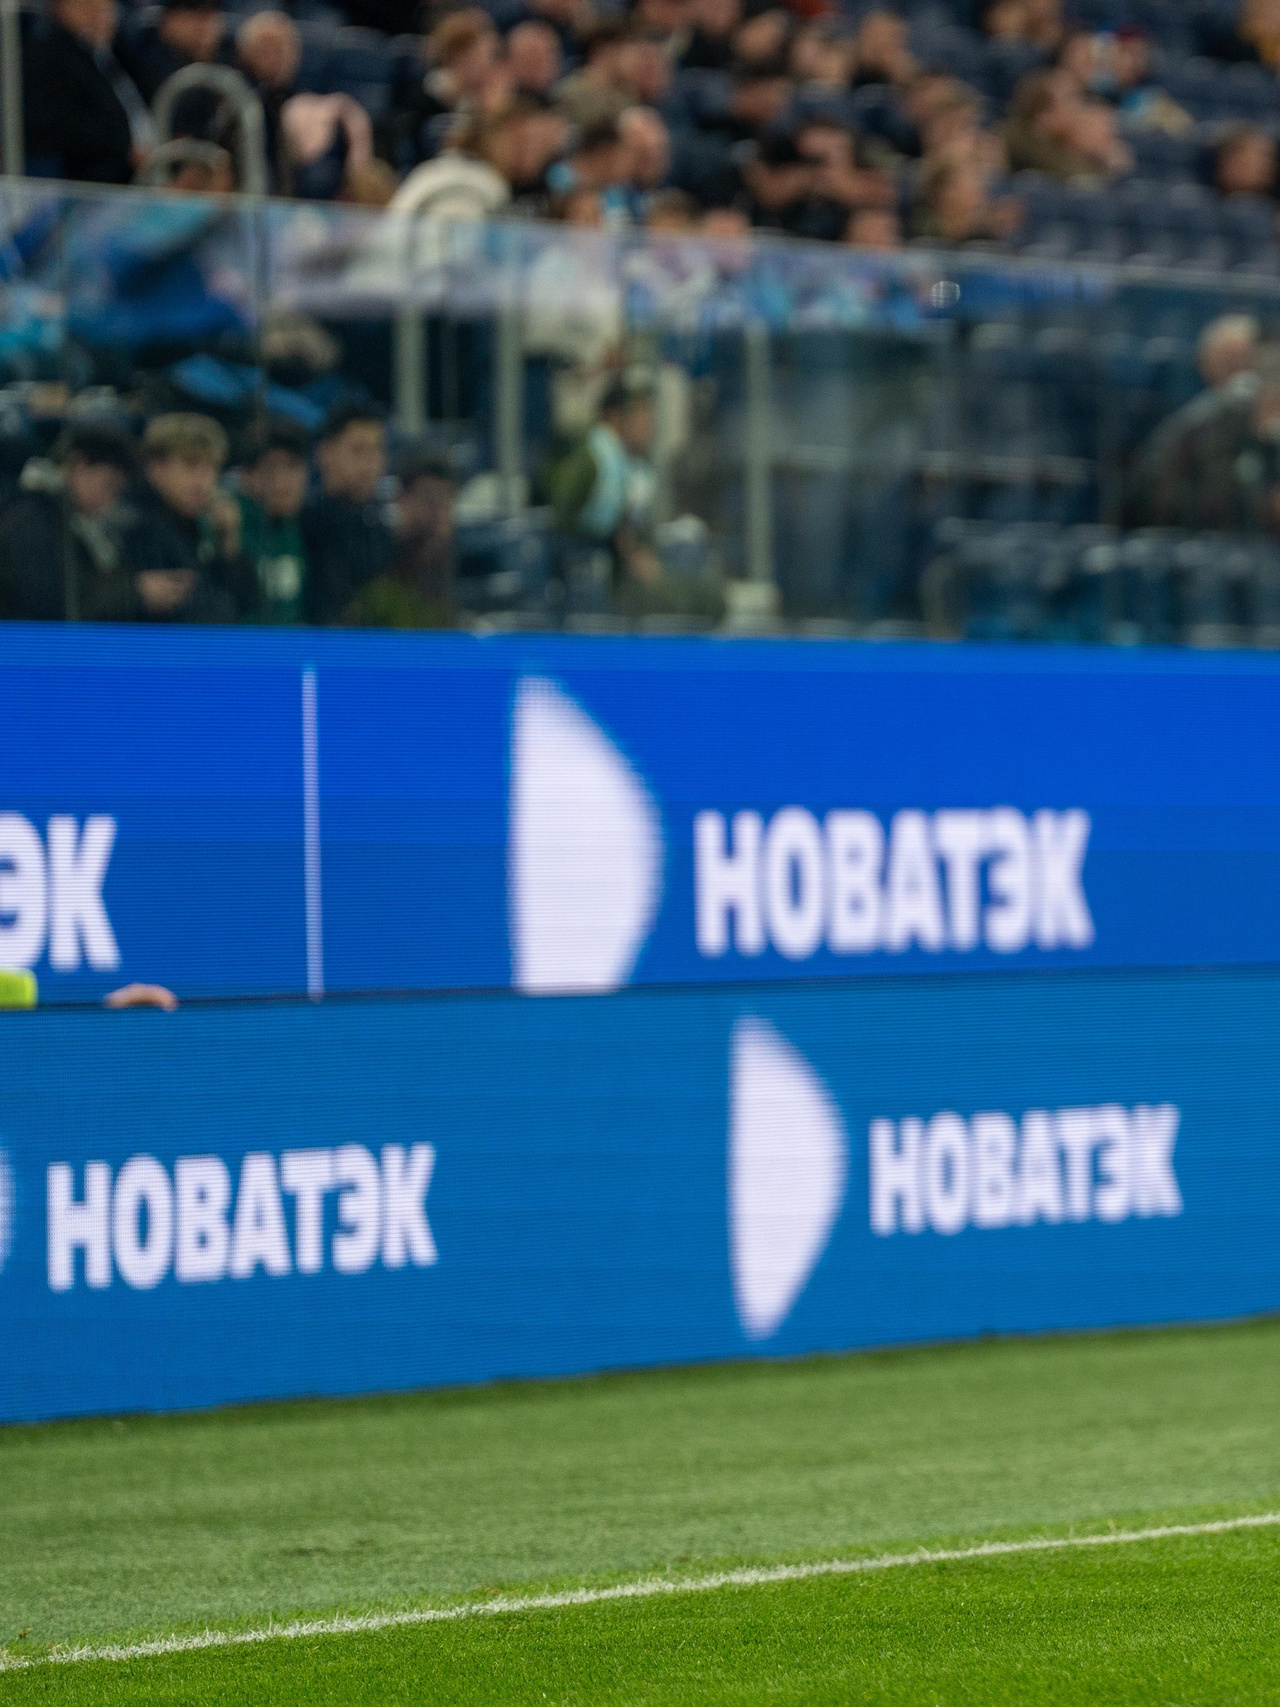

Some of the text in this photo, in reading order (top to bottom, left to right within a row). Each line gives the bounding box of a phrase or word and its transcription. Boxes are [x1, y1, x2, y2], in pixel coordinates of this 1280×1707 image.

[694, 806, 1093, 958] НОВАТЭК
[46, 1142, 437, 1292] НОВАТЭК
[869, 1103, 1182, 1235] НОВАТЭК
